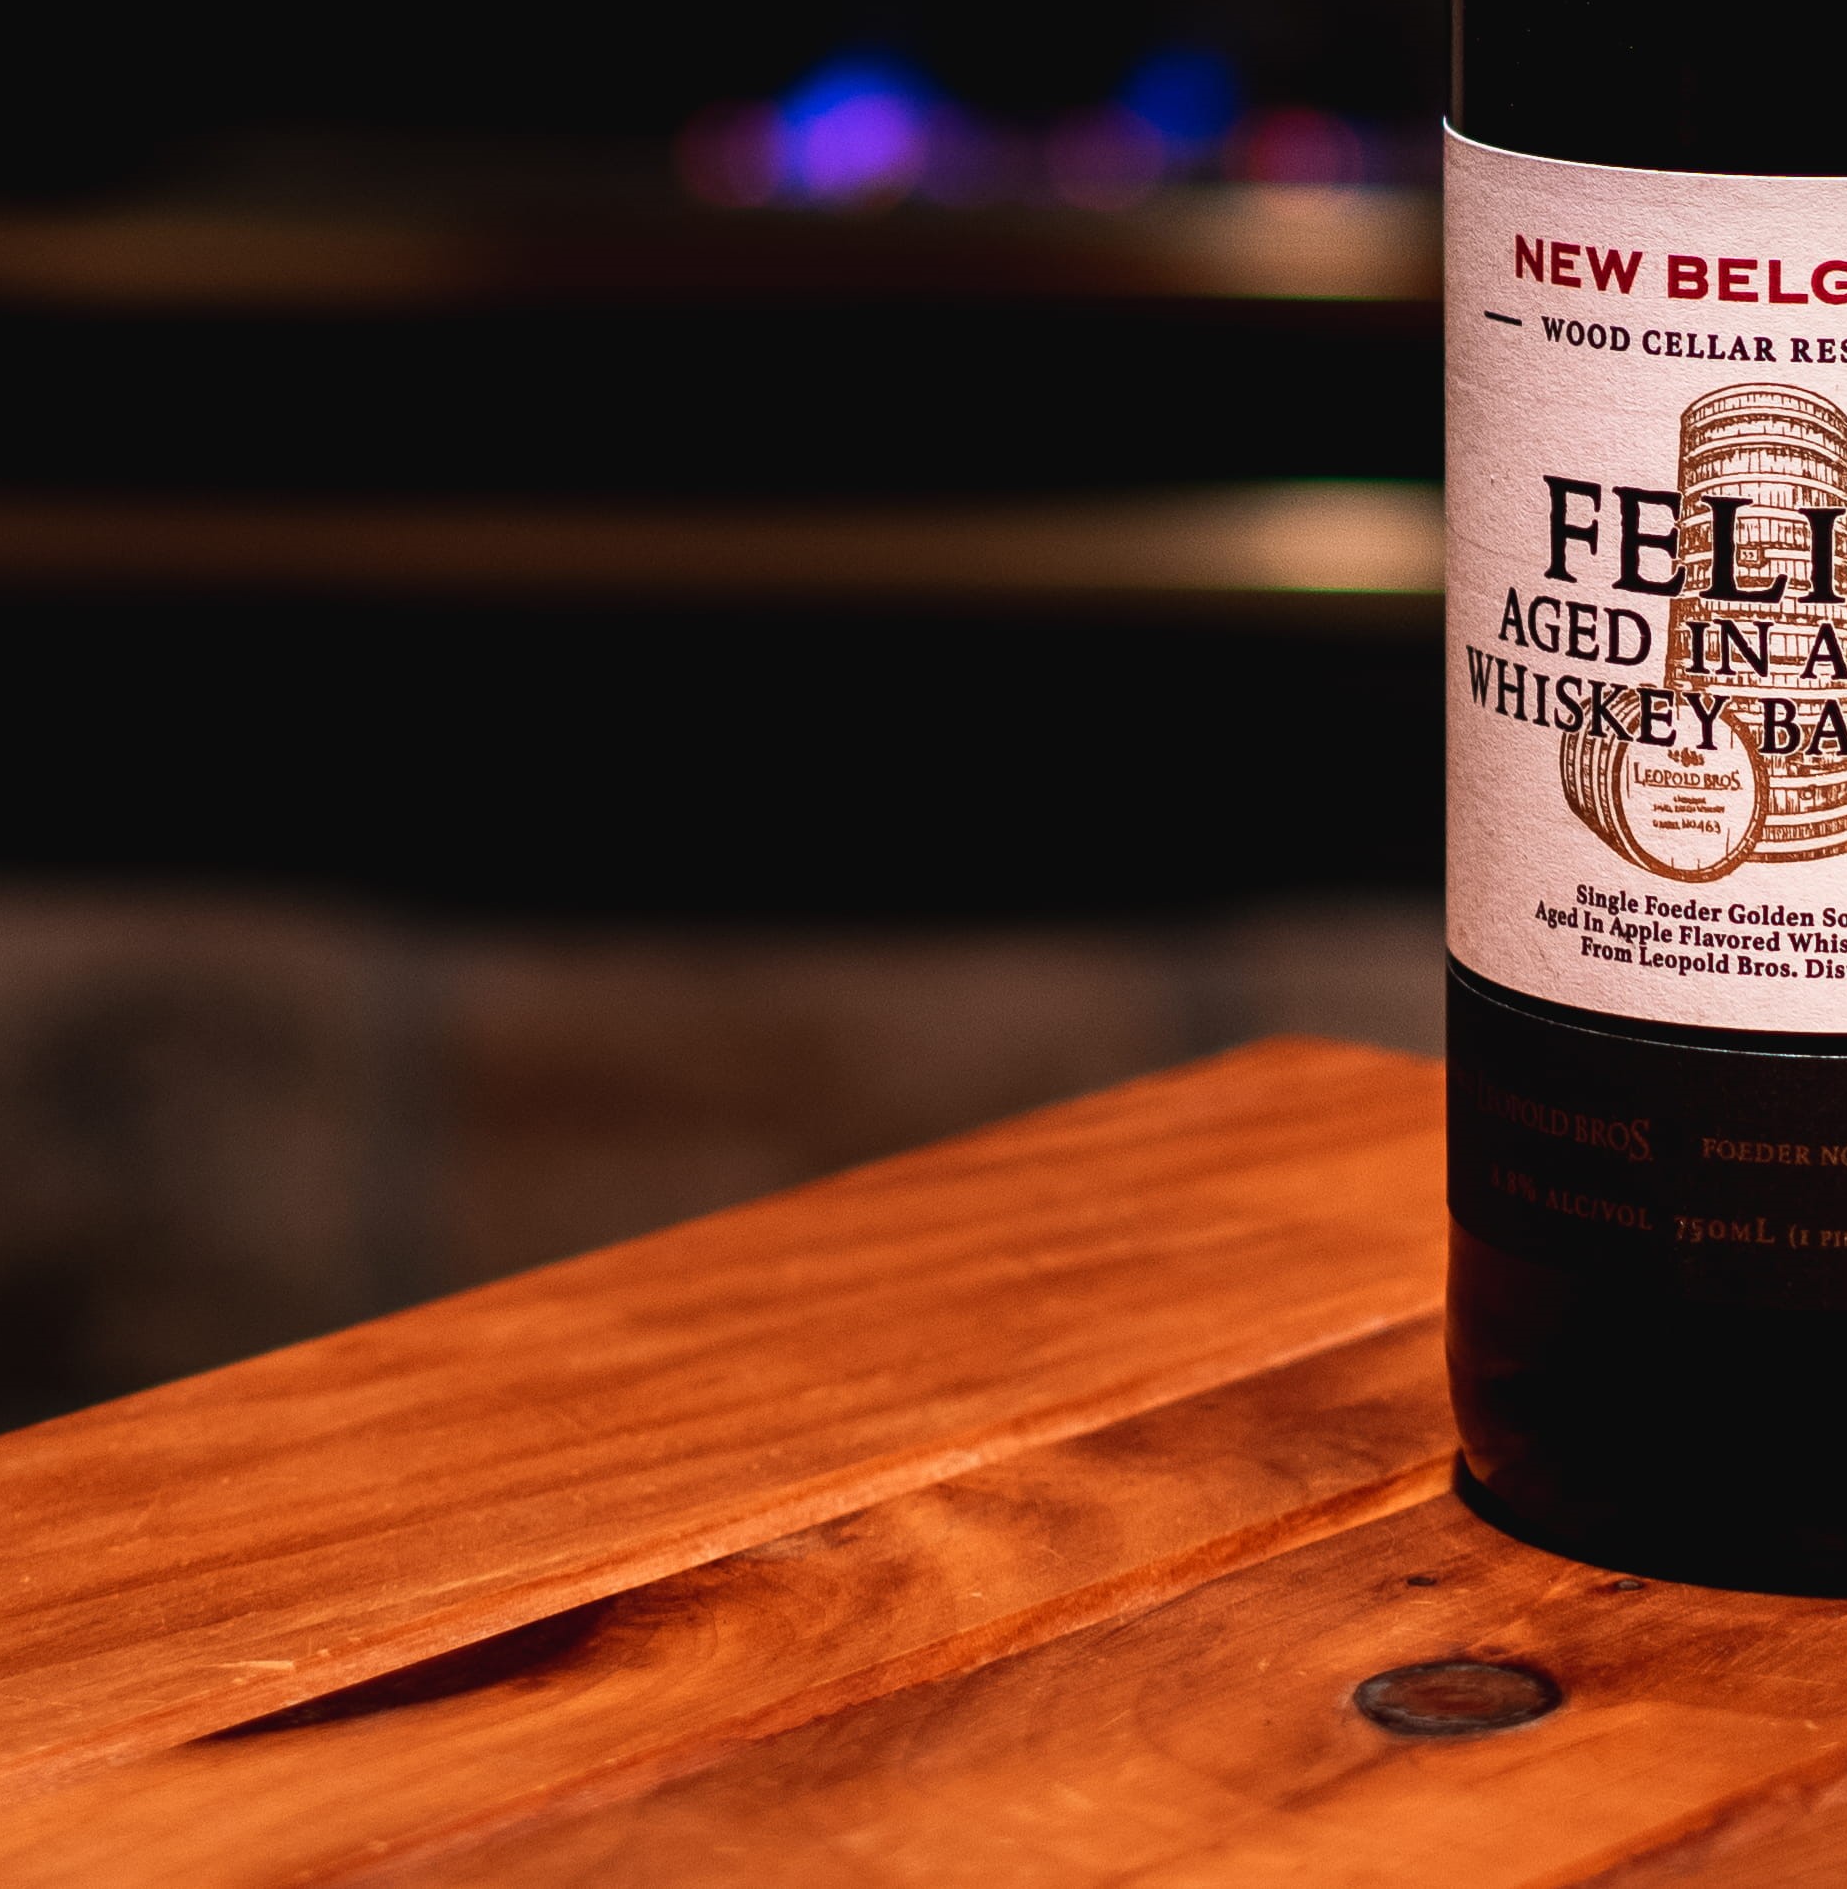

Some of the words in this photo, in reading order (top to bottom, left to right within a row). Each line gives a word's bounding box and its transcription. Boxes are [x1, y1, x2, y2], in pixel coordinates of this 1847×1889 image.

[1515, 234, 1643, 294] NEW
[1541, 315, 1631, 352] WOOD
[1642, 329, 1777, 362] CELLAR
[1497, 586, 1653, 667] AGED
[1685, 619, 1774, 677] IN
[1465, 645, 1730, 752] WHISKEY
[1634, 762, 1701, 787] LEOPOLD
[1535, 899, 1578, 929] Aged
[1583, 910, 1604, 933] In
[1609, 916, 1673, 945] Apple
[1679, 925, 1781, 952] Flavored
[1576, 883, 1639, 915] Single
[1644, 895, 1722, 922] Foeder
[1728, 903, 1814, 927] Golden
[1580, 935, 1633, 963] From
[1639, 946, 1730, 976] Leopold
[1737, 955, 1798, 979] Bros.
[1700, 1136, 1811, 1166] FOEDER
